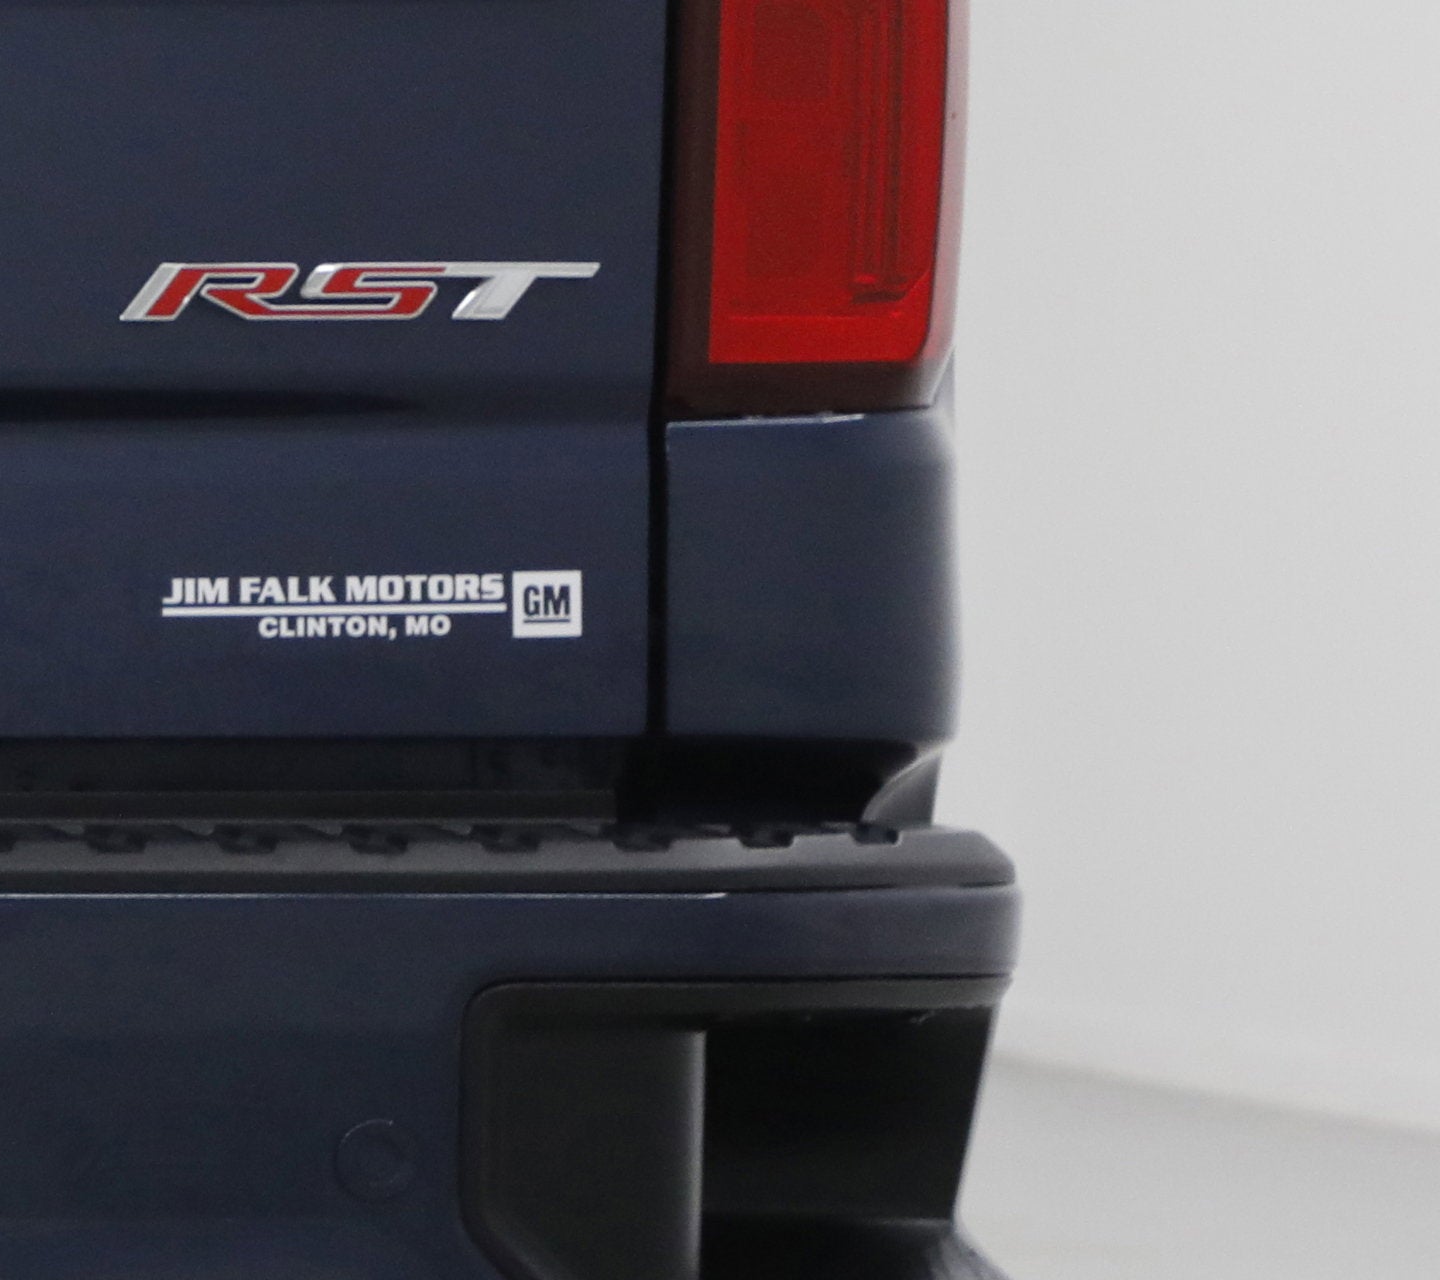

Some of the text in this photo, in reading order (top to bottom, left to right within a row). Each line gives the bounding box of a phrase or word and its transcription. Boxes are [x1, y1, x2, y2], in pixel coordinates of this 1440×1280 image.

[119, 262, 601, 321] RST
[162, 574, 505, 605] JIM FALK MOTORS
[523, 585, 570, 623] GM
[258, 615, 451, 640] CLINTON, MO
